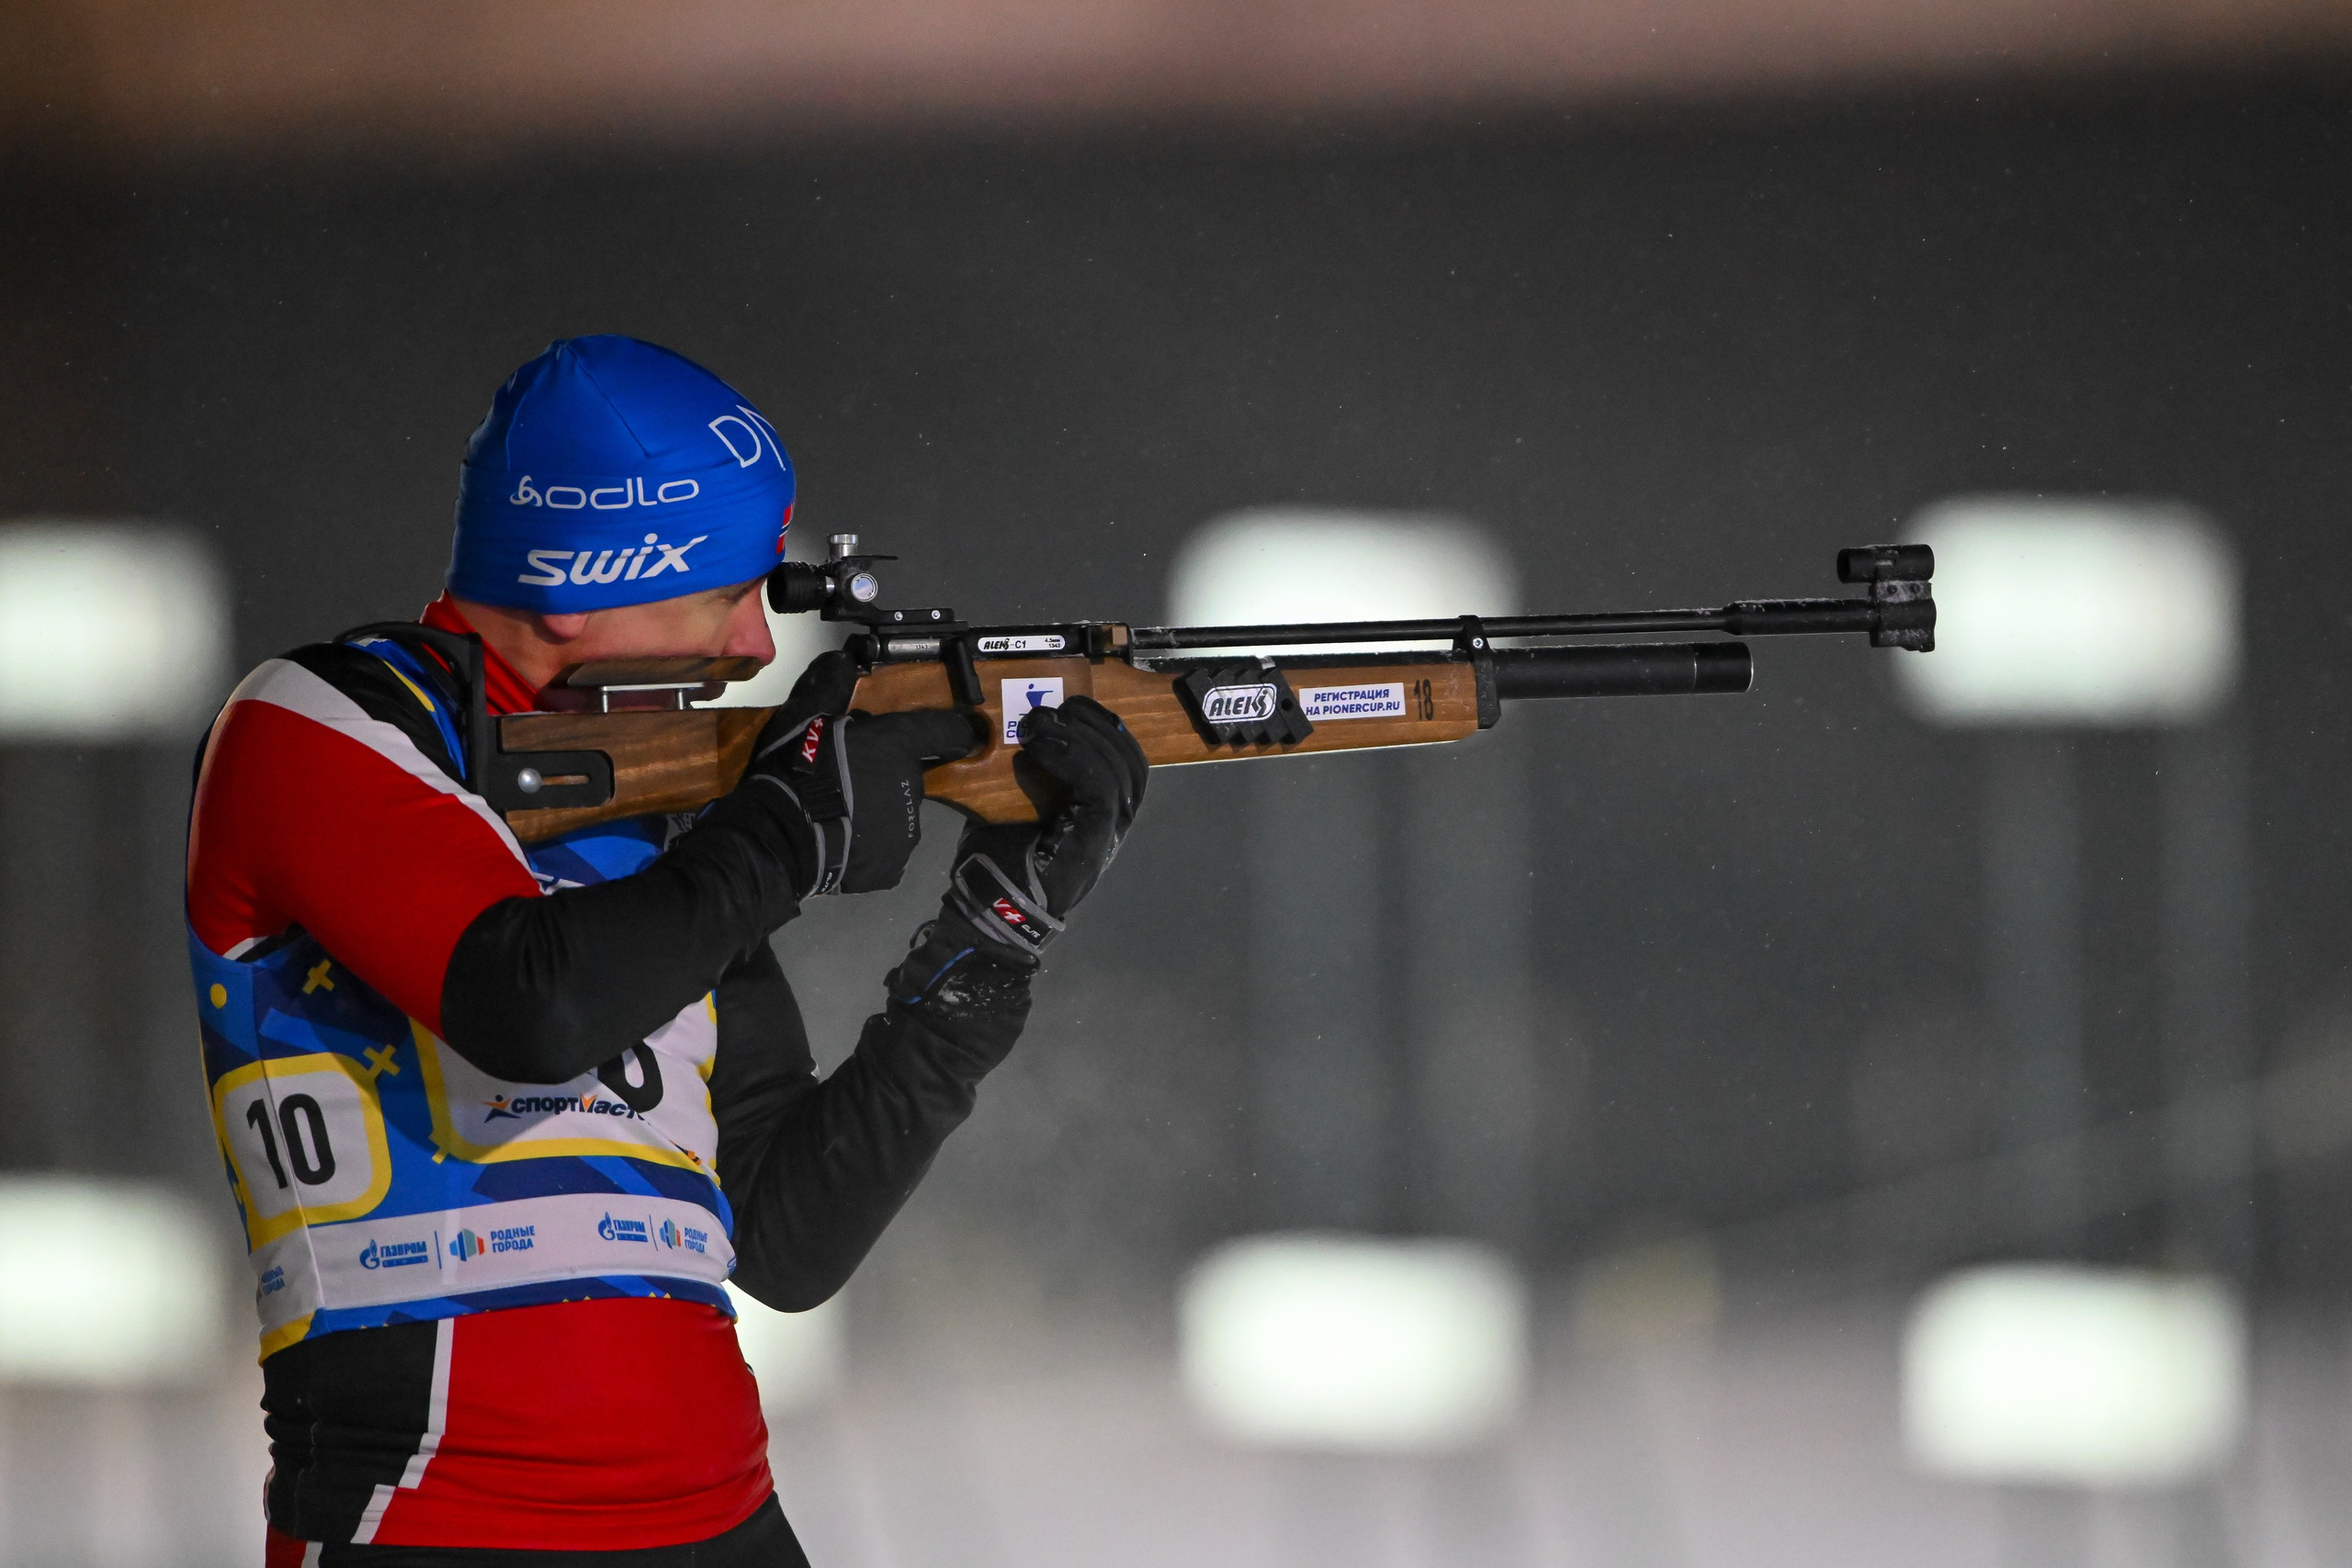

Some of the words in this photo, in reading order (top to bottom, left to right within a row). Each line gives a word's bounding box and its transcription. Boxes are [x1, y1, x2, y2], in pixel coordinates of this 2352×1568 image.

[1314, 689, 1390, 703] РЕГИСТРАЦИЯ
[1413, 679, 1434, 721] 18
[1306, 705, 1321, 716] НА
[1323, 701, 1401, 716] PIONERCUP.RU
[246, 1093, 336, 1190] 10
[490, 1225, 536, 1241] РОДНЫЕ
[380, 1241, 427, 1258] ГАЗПРОМ
[492, 1238, 534, 1253] ГОРОДА
